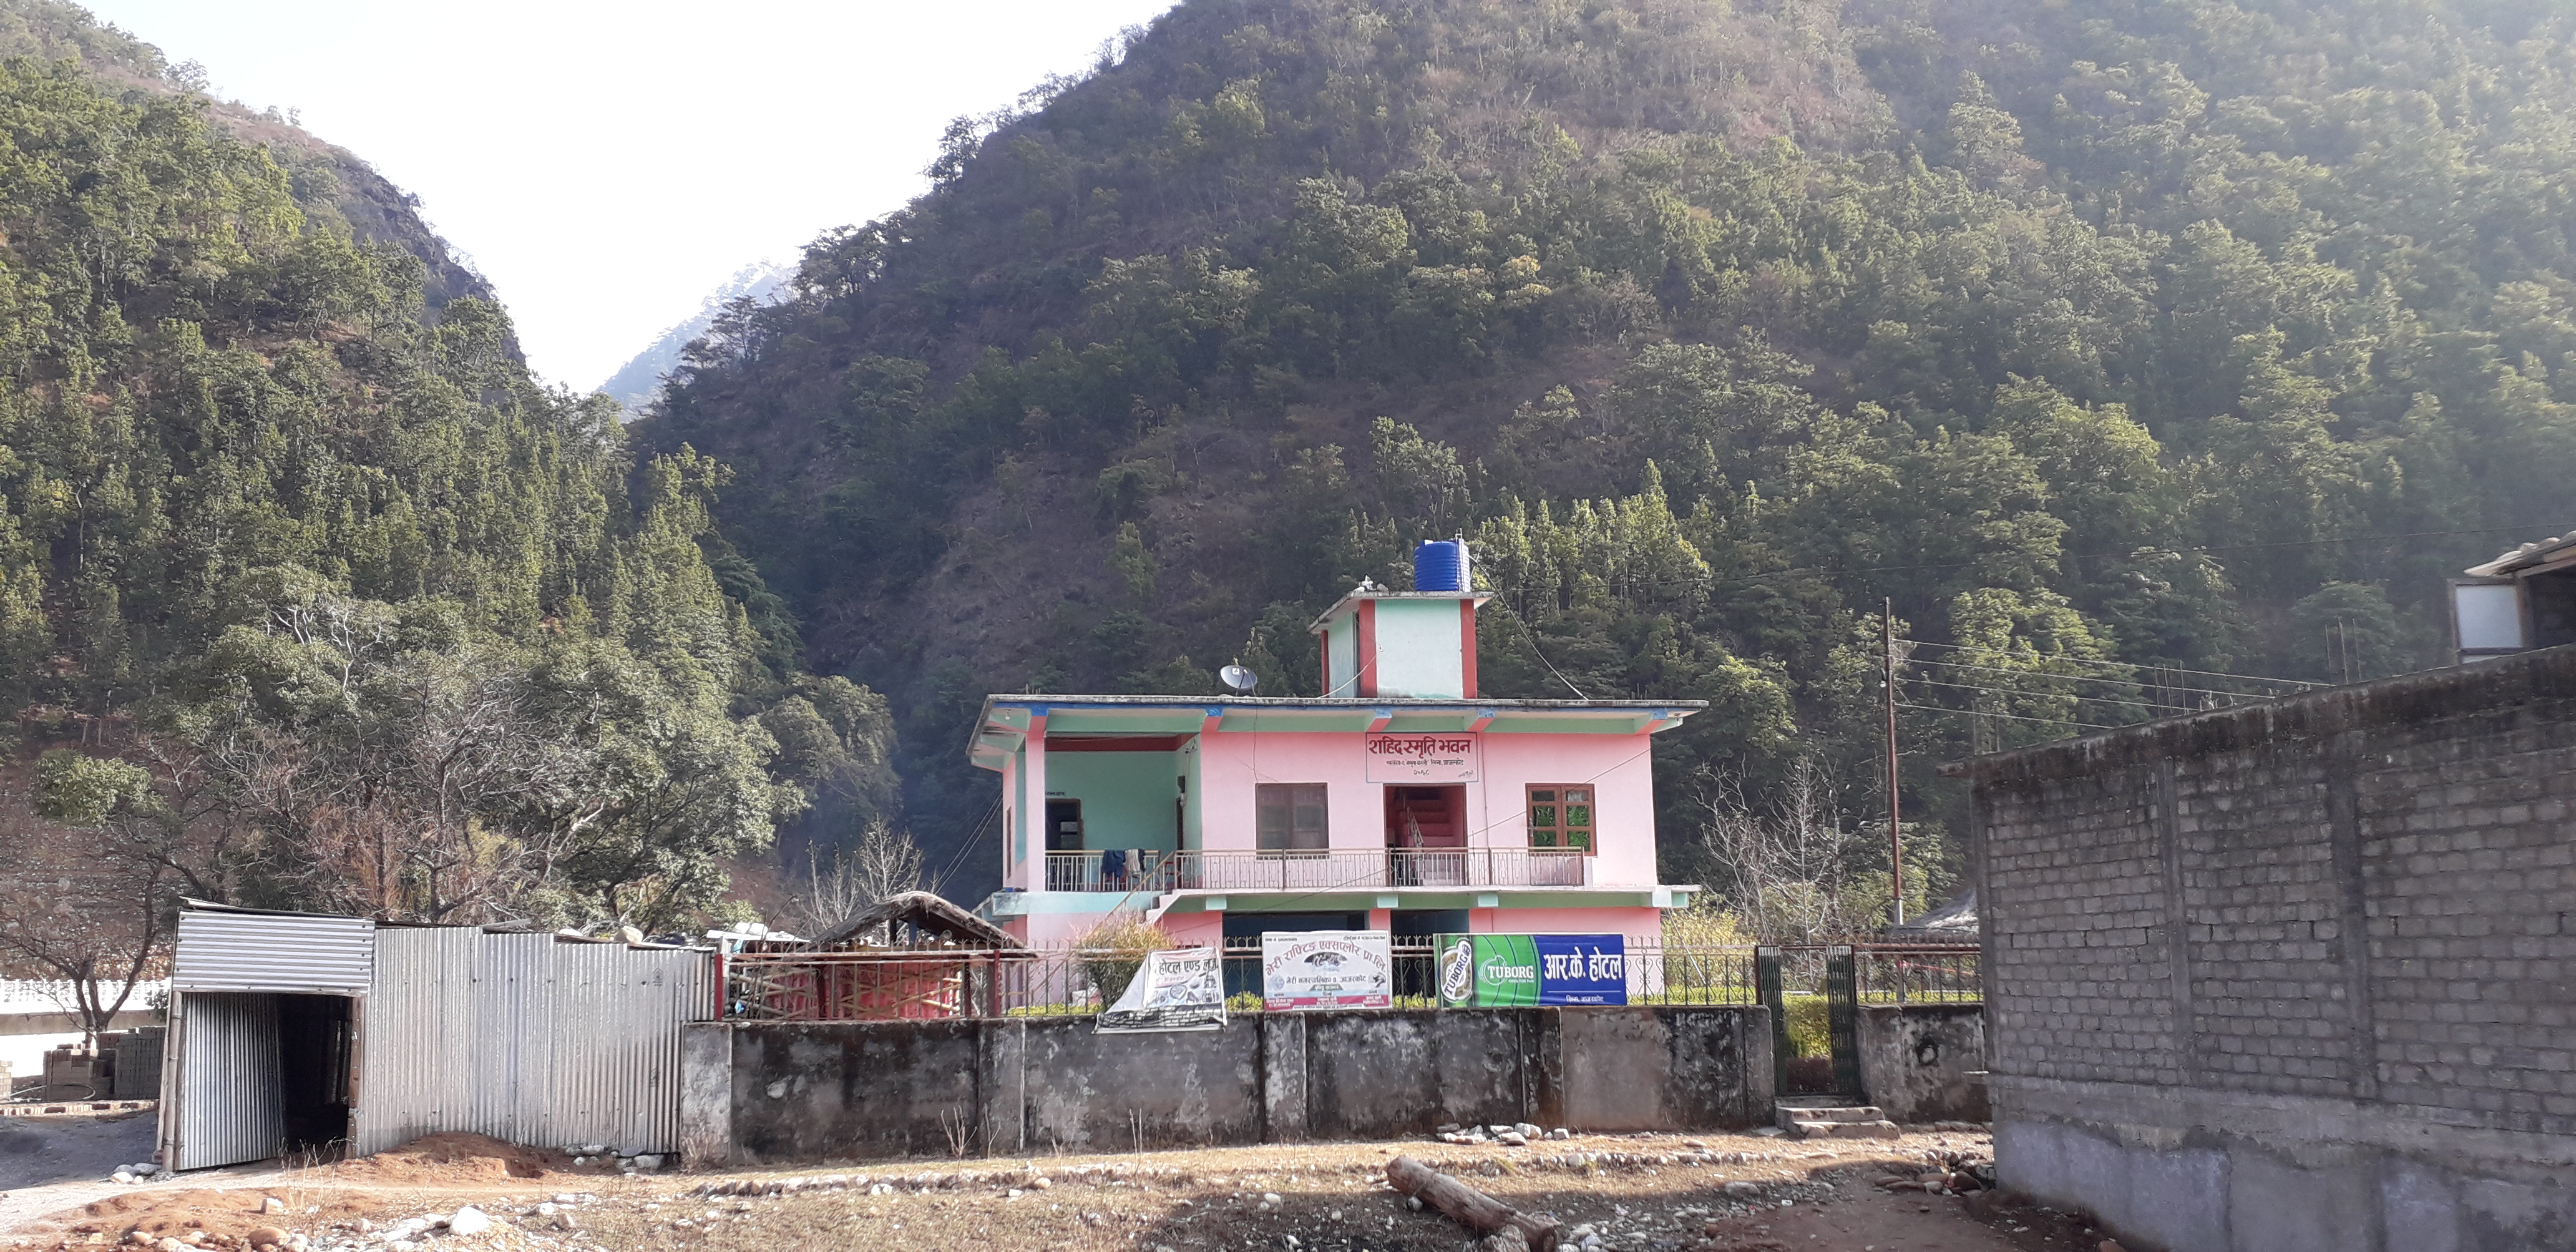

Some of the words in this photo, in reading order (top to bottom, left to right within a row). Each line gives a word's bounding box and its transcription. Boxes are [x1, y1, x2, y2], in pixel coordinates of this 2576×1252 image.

[1403, 735, 1436, 759] स्मृति
[1438, 739, 1471, 753] भवन
[1159, 958, 1181, 975] होटल
[1183, 959, 1200, 972] एण्ड
[1265, 956, 1282, 976] भेरी
[1319, 939, 1361, 956] एक्सप्लोर
[1363, 949, 1386, 973] प्रा.लि.
[1487, 965, 1534, 979] TUBORG
[1543, 946, 1586, 981] आर.के.
[1588, 946, 1622, 982] होटल
[1444, 954, 1468, 995] TUBORG
